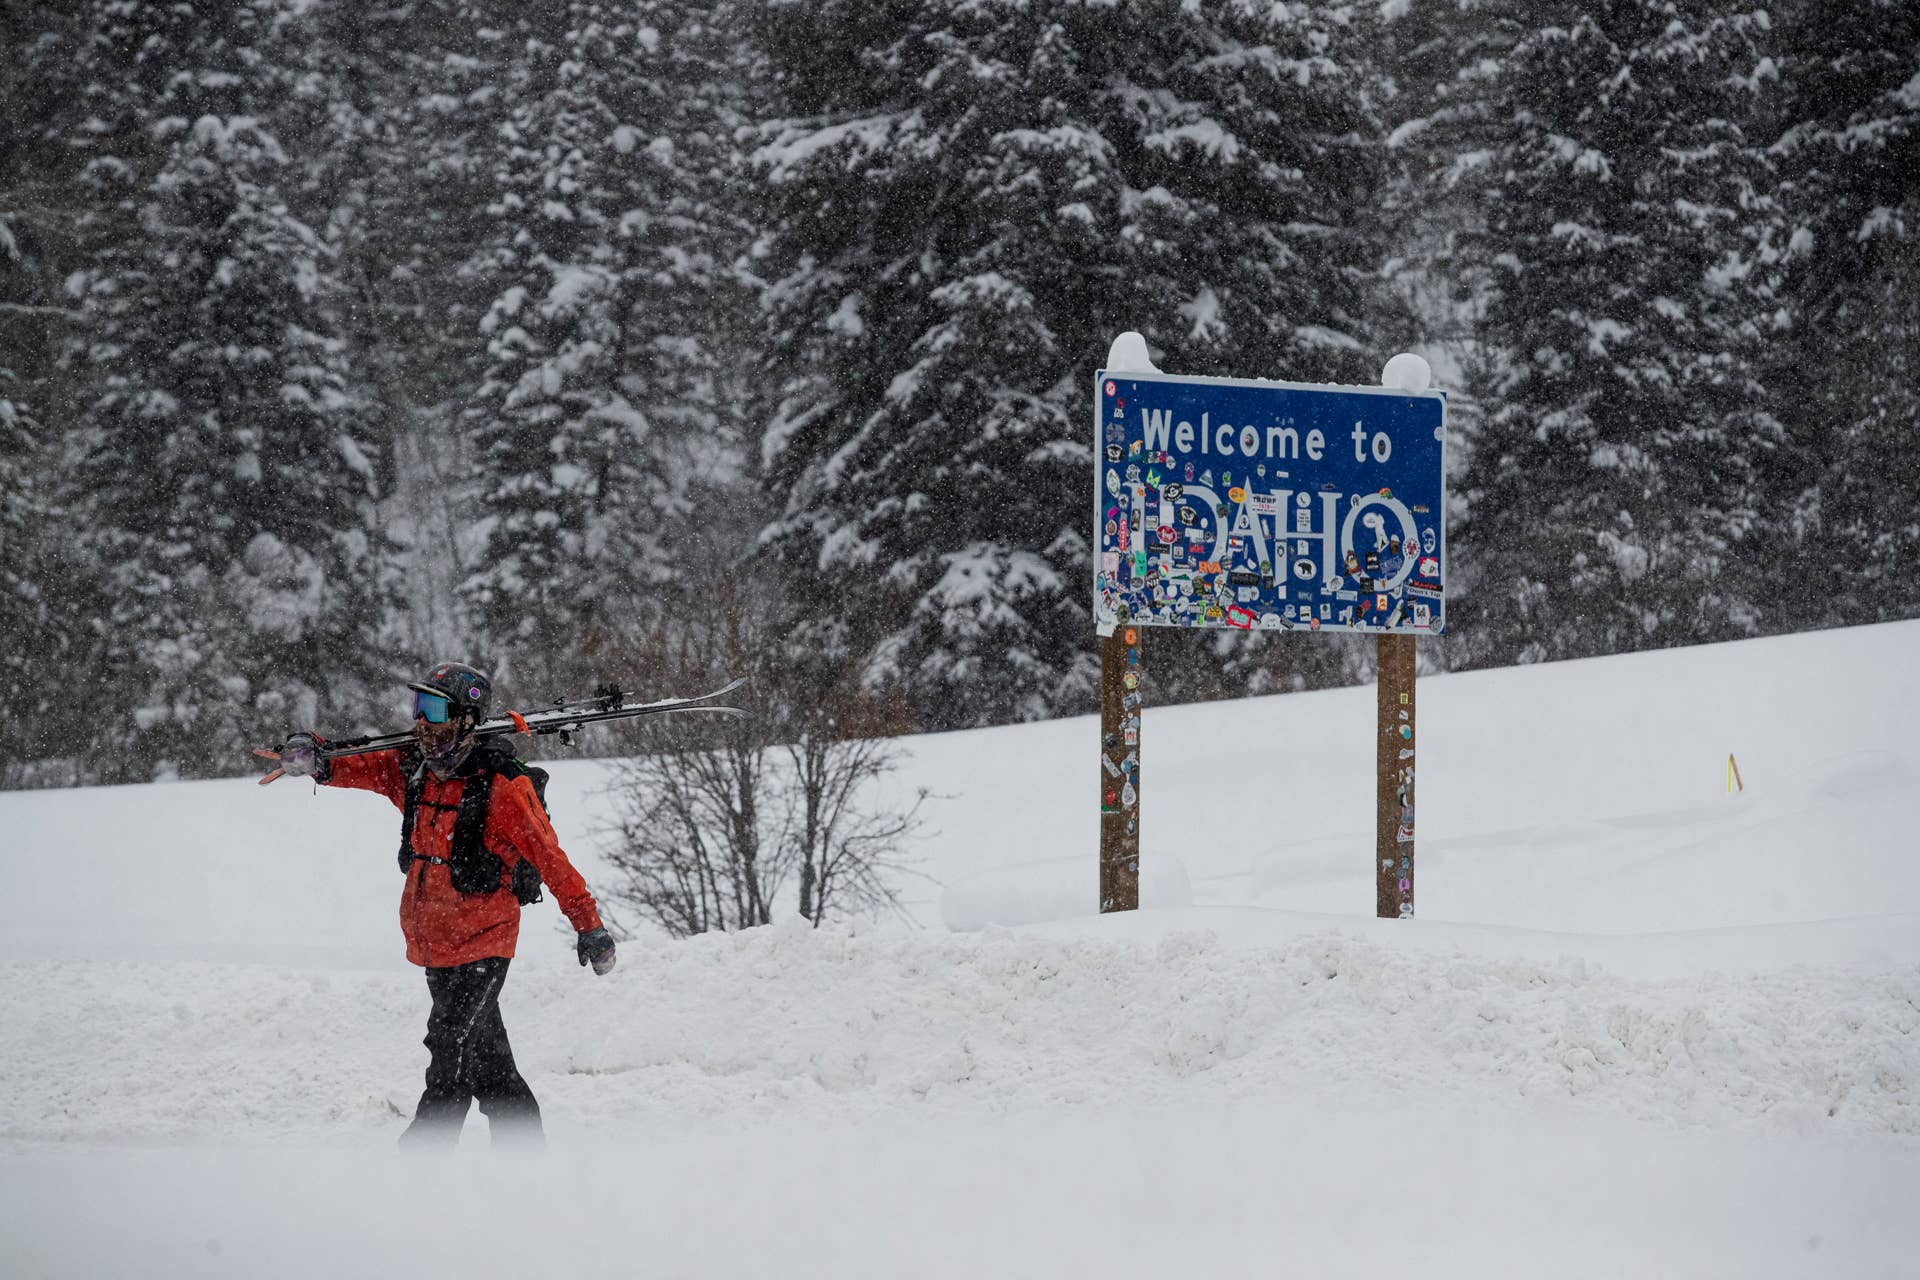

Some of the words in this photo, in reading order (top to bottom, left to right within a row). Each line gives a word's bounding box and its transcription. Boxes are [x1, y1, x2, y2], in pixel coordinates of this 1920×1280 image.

[1141, 407, 1326, 461] Welcome
[1351, 419, 1392, 464] to
[1253, 495, 1277, 504] TRUMP
[1122, 475, 1418, 592] IDAHO
[1199, 560, 1223, 574] RVA
